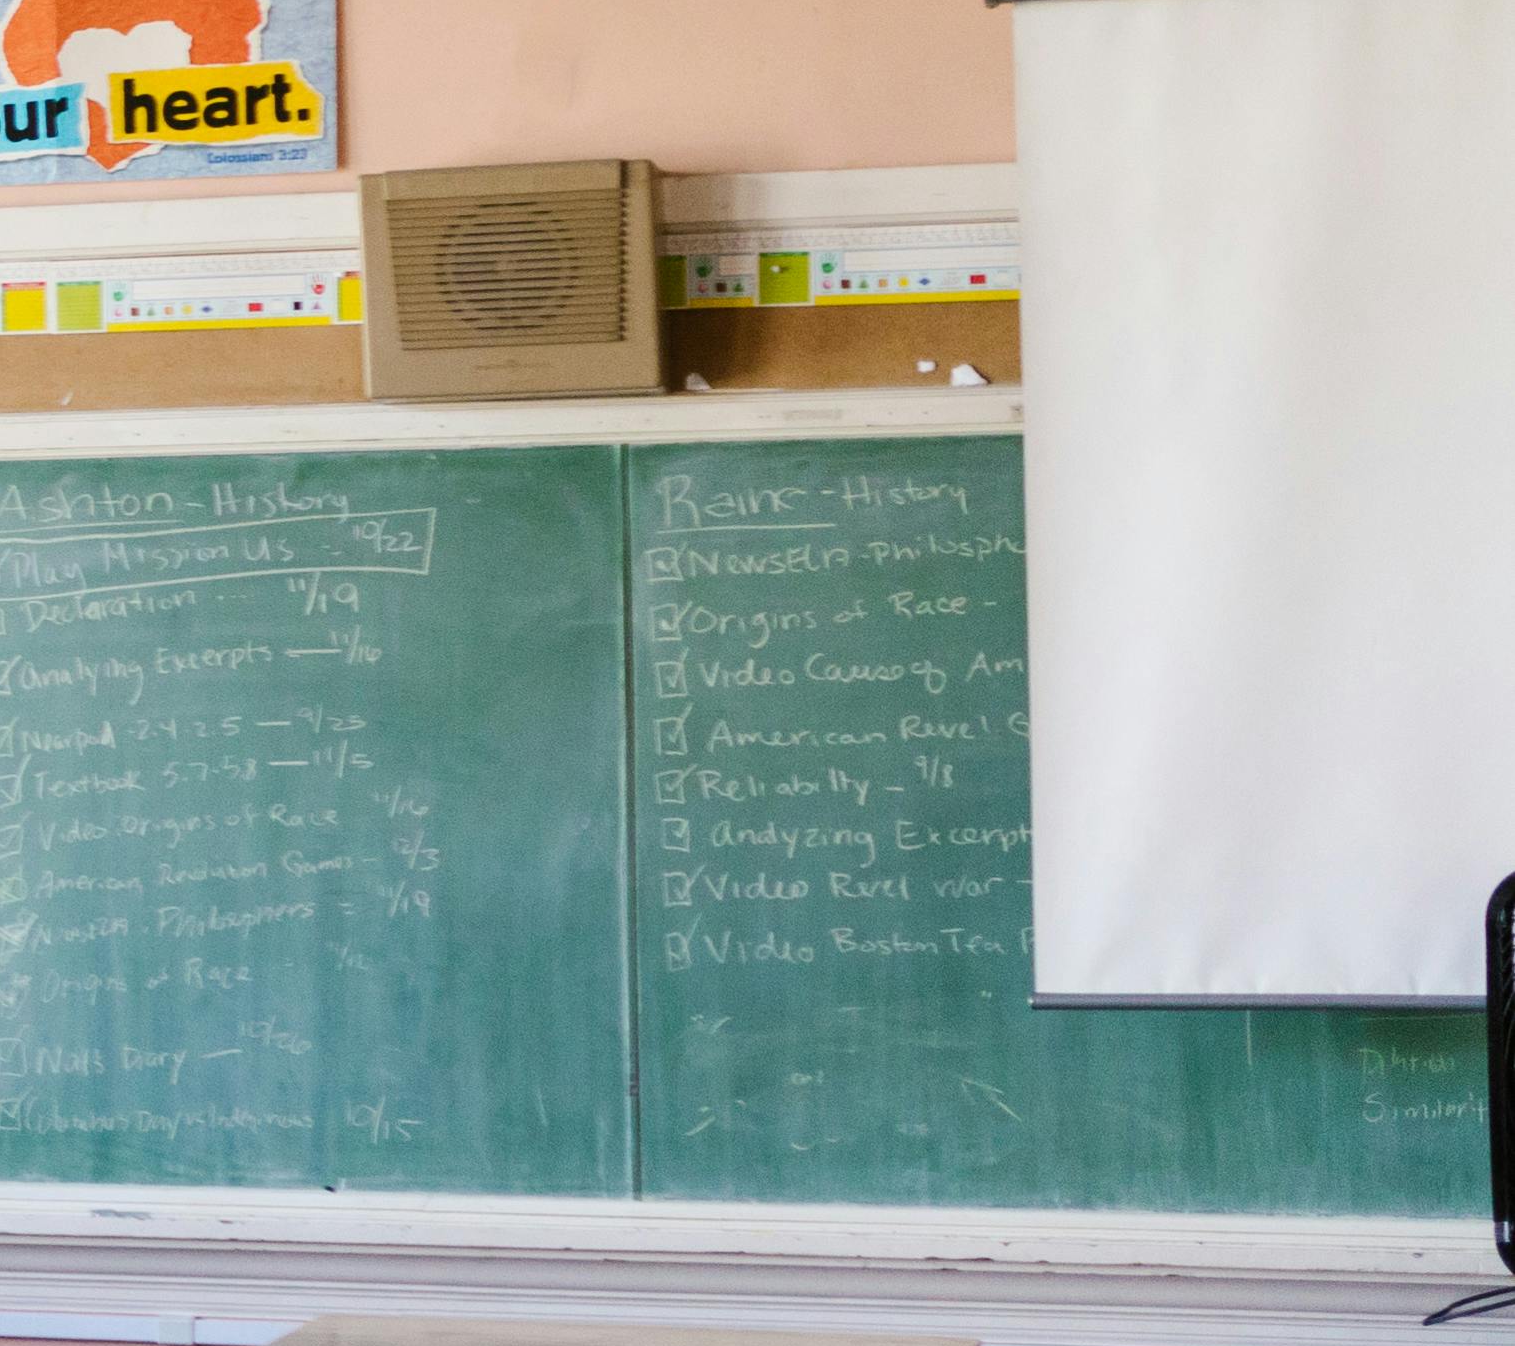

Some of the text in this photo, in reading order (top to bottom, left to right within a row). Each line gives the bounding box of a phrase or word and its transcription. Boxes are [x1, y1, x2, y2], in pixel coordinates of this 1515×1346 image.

[123, 73, 310, 134] heart.
[212, 482, 350, 522] History
[842, 476, 968, 515] History
[13, 550, 87, 594] Play
[352, 519, 423, 553] 10/22
[20, 589, 197, 633] Declaration
[690, 591, 967, 649] Origins of Race
[698, 656, 795, 689] Video
[965, 652, 1024, 683] Am
[709, 720, 886, 753] American
[895, 819, 1033, 852] Excerpt
[706, 871, 809, 902] Video
[705, 929, 814, 964] Video
[1362, 1091, 1488, 1124] Similarit
